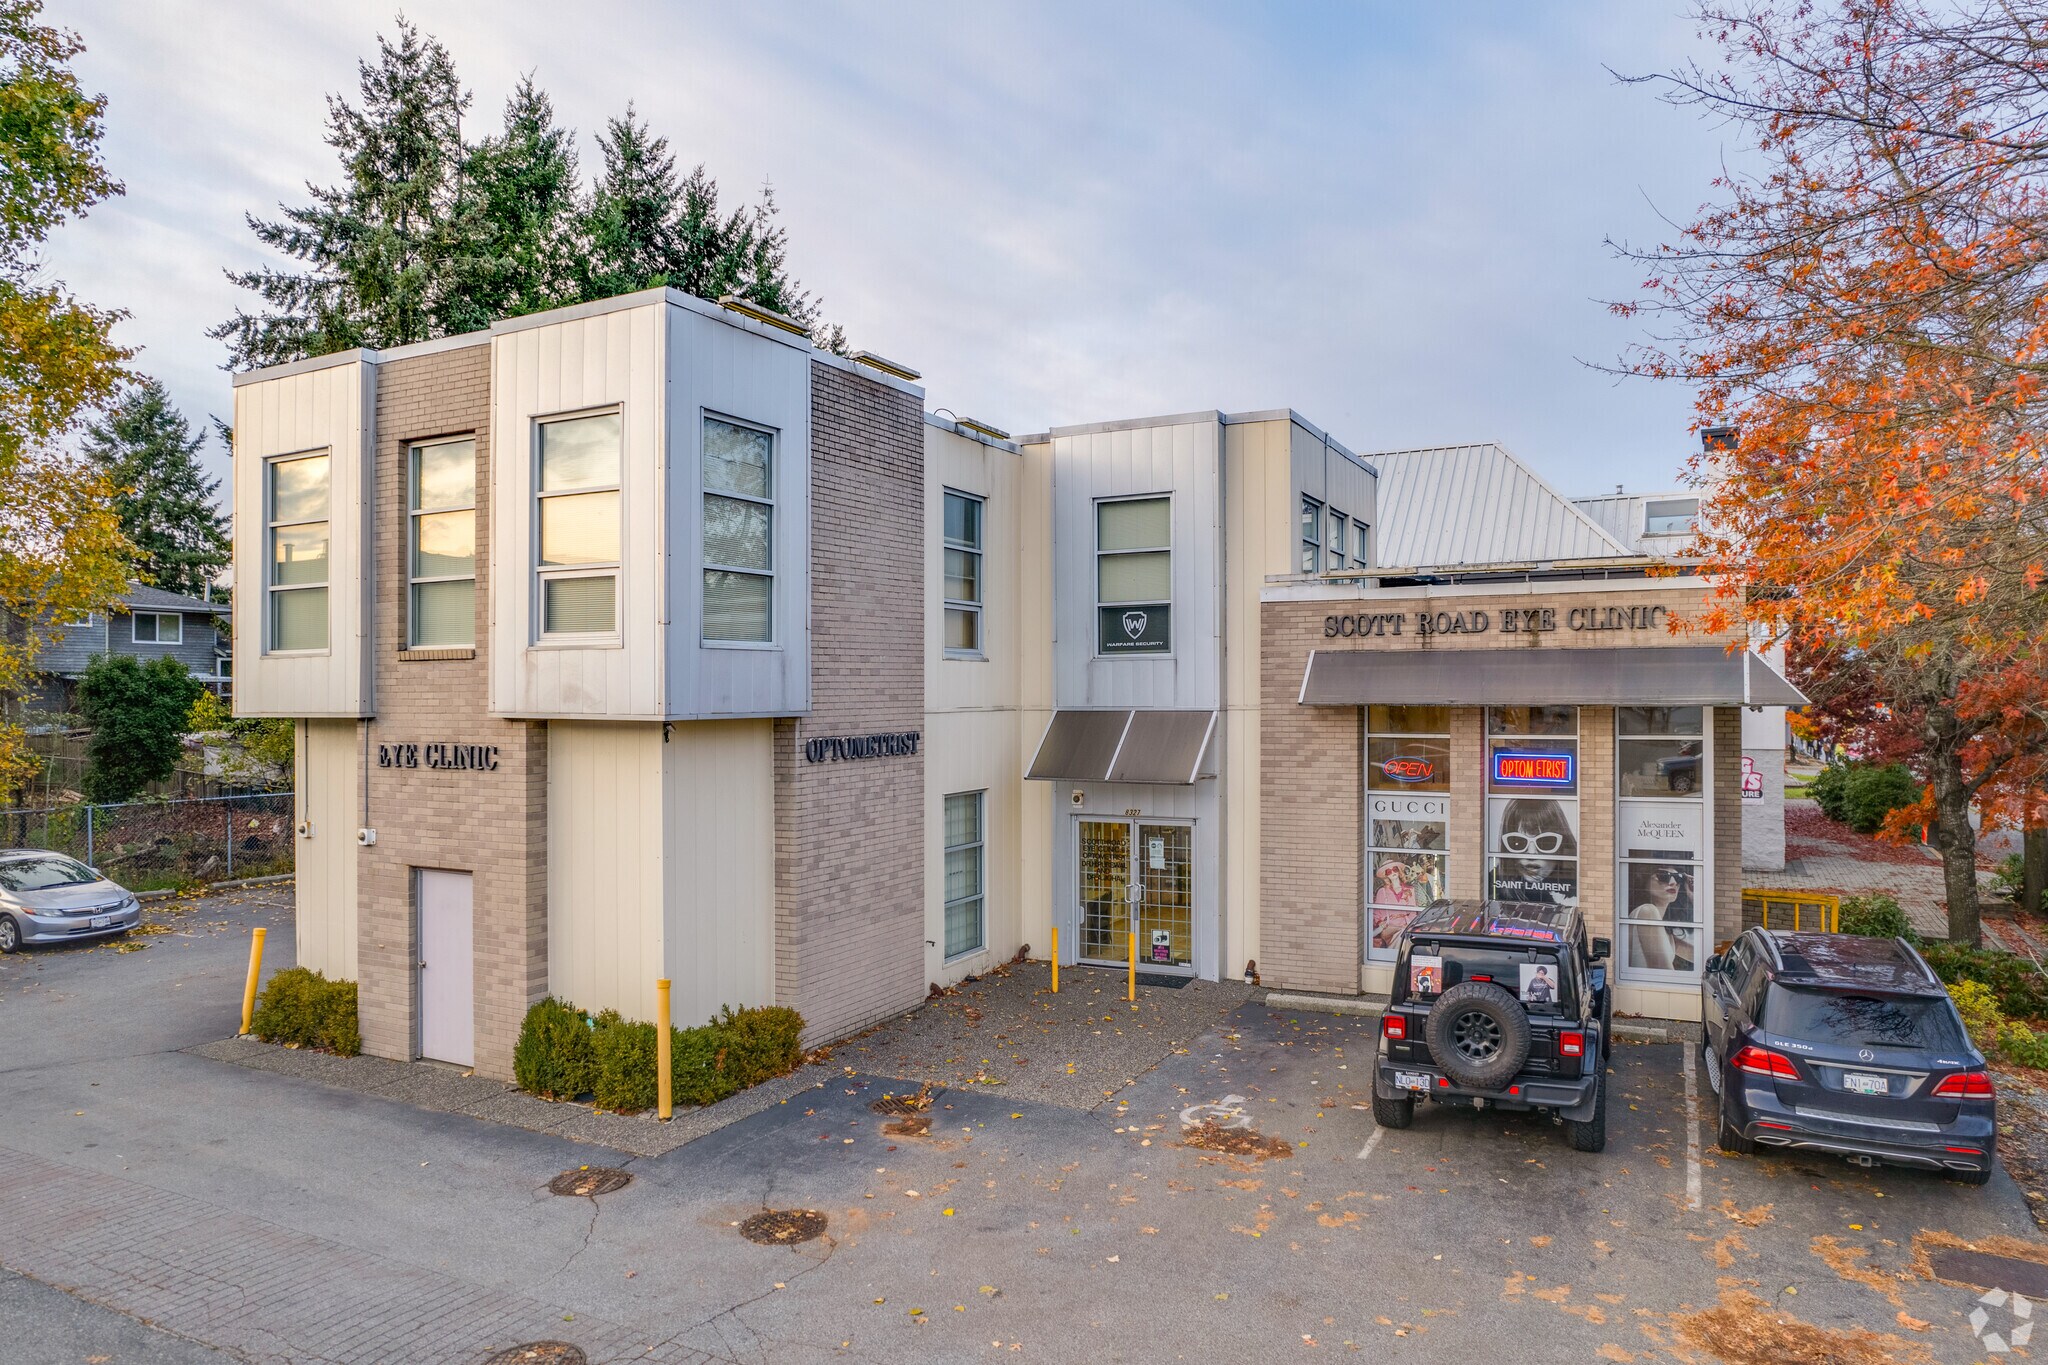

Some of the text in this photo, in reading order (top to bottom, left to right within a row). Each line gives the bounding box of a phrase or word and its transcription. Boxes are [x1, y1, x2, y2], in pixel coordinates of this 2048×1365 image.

[1324, 605, 1667, 638] SCOTT ROAD EYE CLINIC
[805, 731, 920, 763] OPTOMETRIST
[378, 743, 498, 771] EYE CLINIC
[1384, 760, 1433, 777] OPEN
[1375, 800, 1444, 815] GUCCI
[1640, 820, 1682, 829] Alexander
[1637, 829, 1685, 839] McQUEEN
[1495, 880, 1572, 892] SAINT LAURENT
